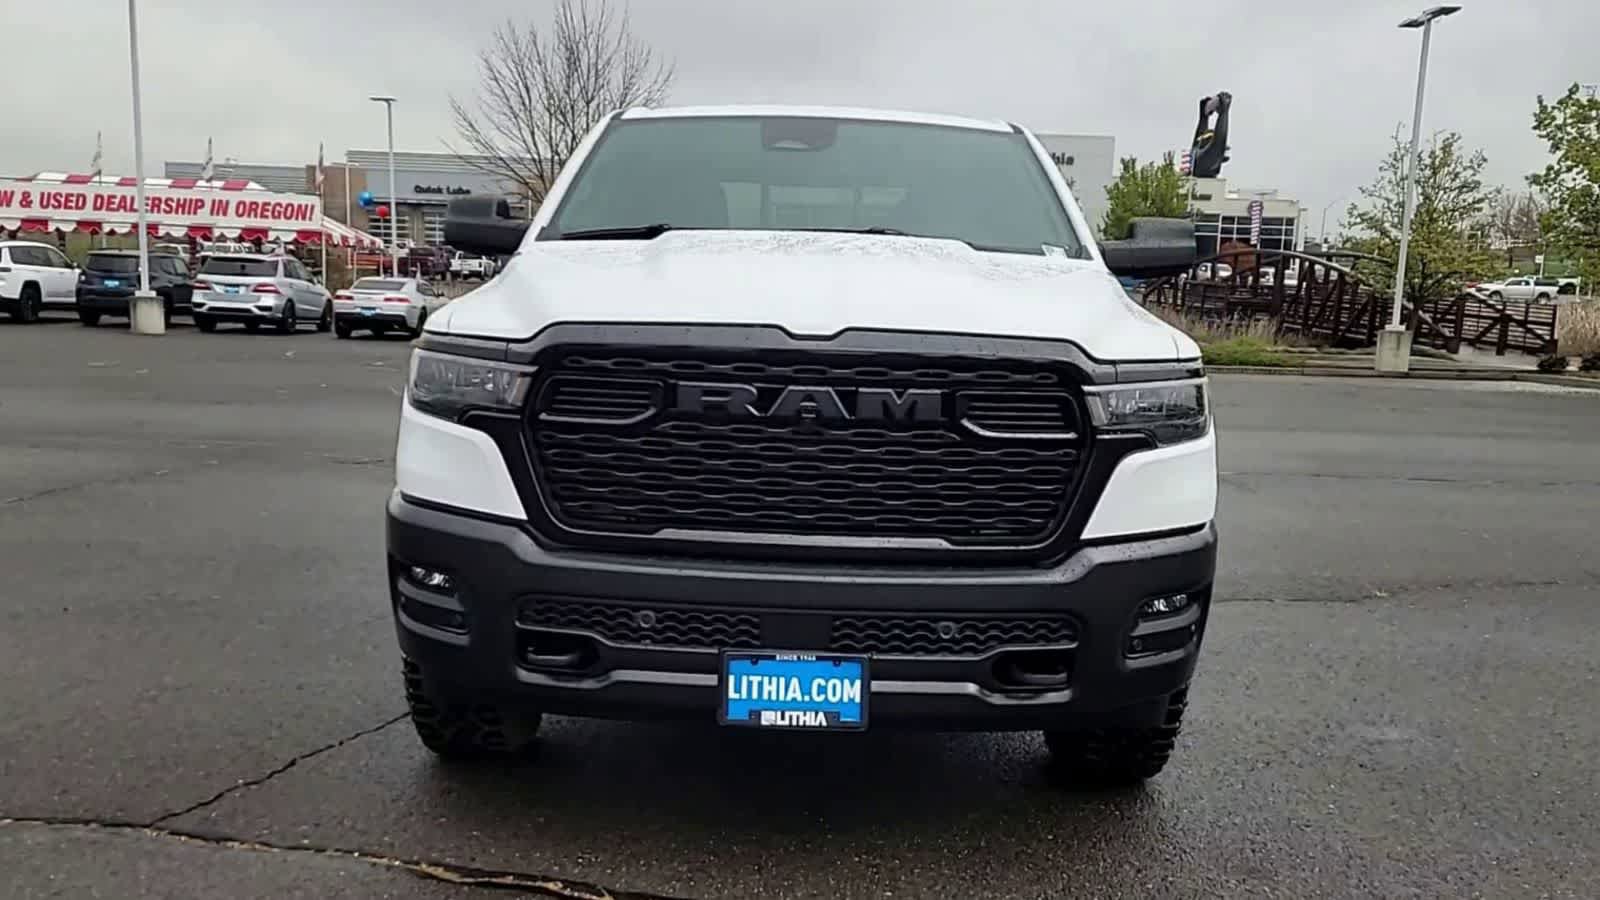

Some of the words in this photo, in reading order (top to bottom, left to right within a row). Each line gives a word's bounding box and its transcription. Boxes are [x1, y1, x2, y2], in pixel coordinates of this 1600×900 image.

[414, 184, 443, 194] Quick
[446, 184, 472, 195] Lube
[19, 191, 33, 208] &
[39, 191, 87, 210] USED
[210, 198, 229, 217] IN
[235, 200, 315, 222] OREGON!
[666, 380, 948, 420] RAM
[727, 674, 862, 704] LITHIA.COM
[777, 710, 828, 727] LITHIA
